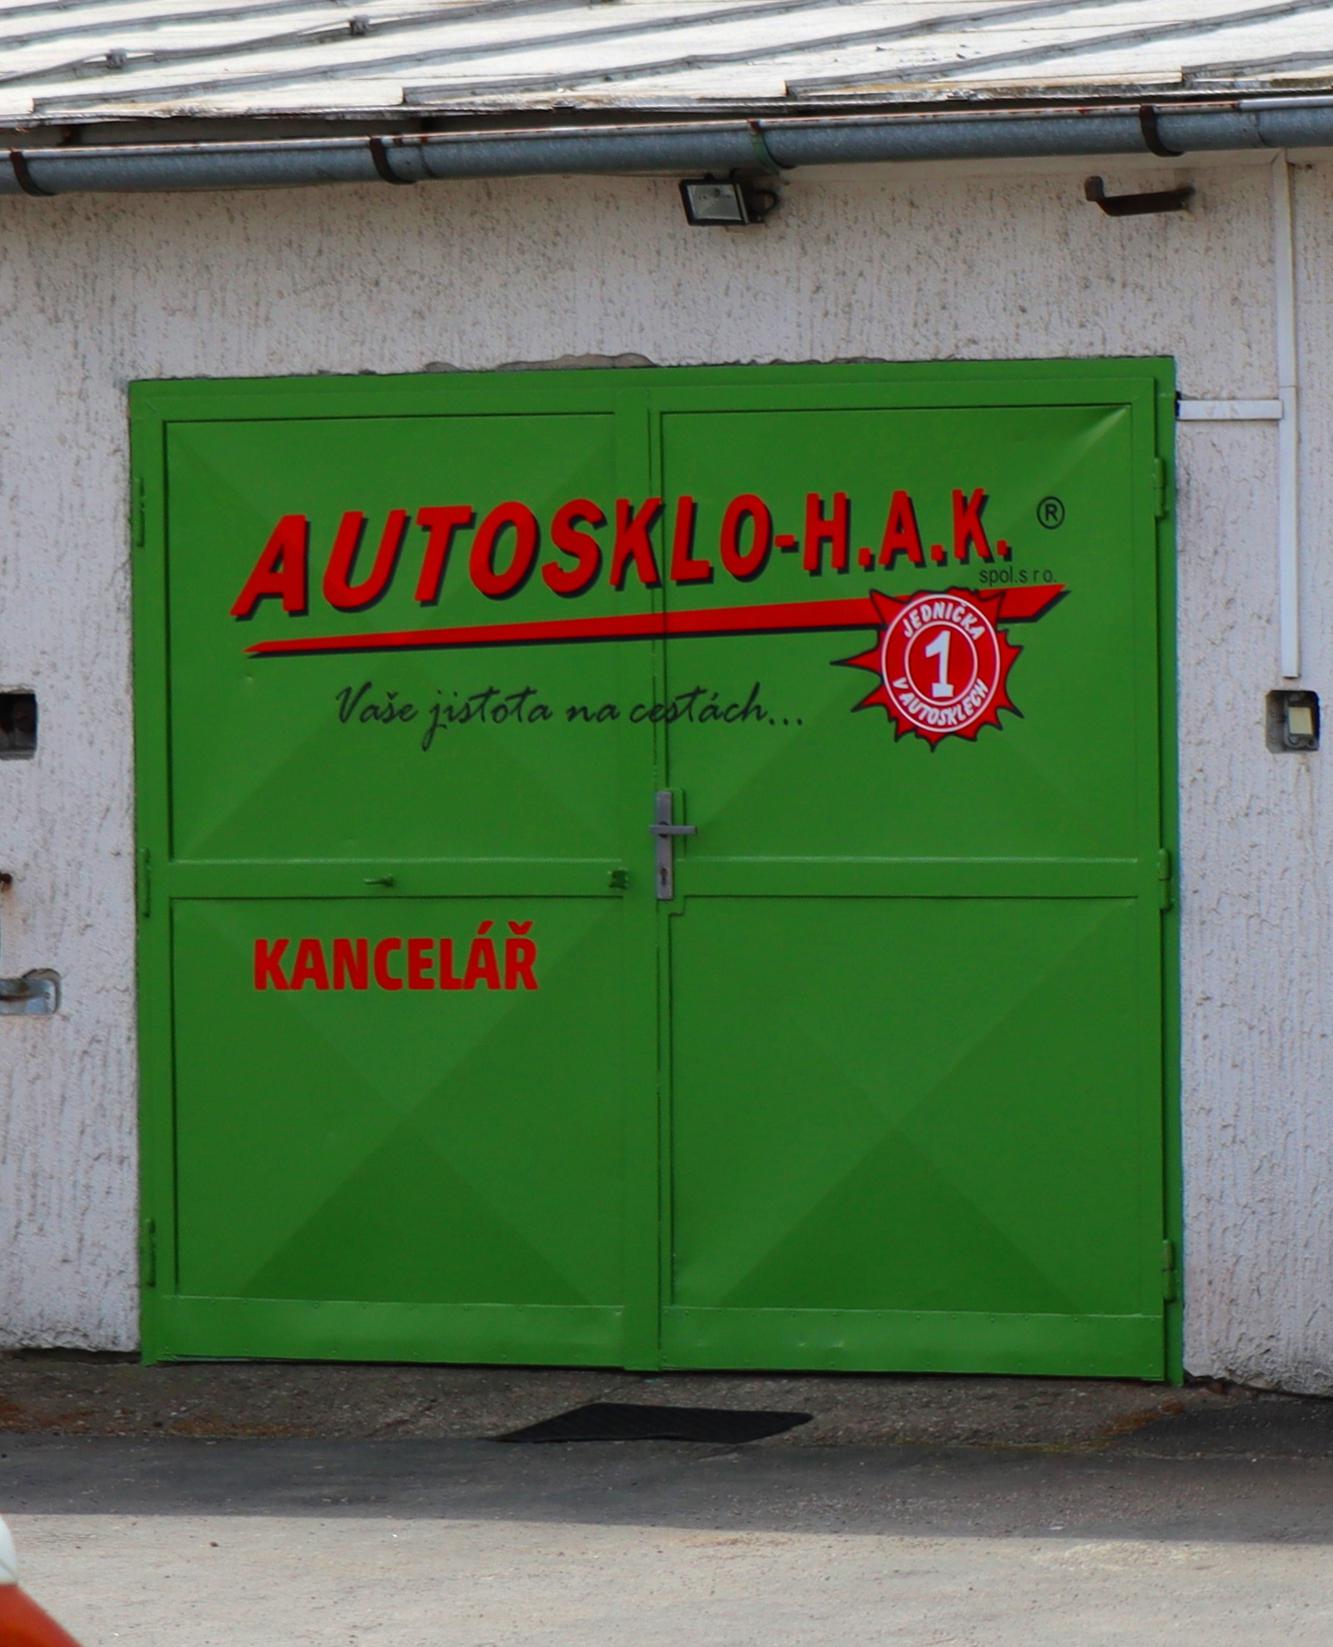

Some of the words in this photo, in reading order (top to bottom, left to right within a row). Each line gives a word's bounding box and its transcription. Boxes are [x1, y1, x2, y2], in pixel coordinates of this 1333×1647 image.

[230, 487, 1012, 621] AUTOSKLO-H.A.K.
[903, 601, 985, 640] JEDNIČKA
[925, 629, 954, 698] 1
[334, 681, 418, 726] Vaše
[421, 686, 554, 753] jistota
[566, 702, 620, 726] na
[628, 682, 805, 727] cestách...
[891, 677, 909, 690] V
[900, 678, 989, 726] AUTOSKLECH
[253, 919, 539, 991] KANCELÁŘ
